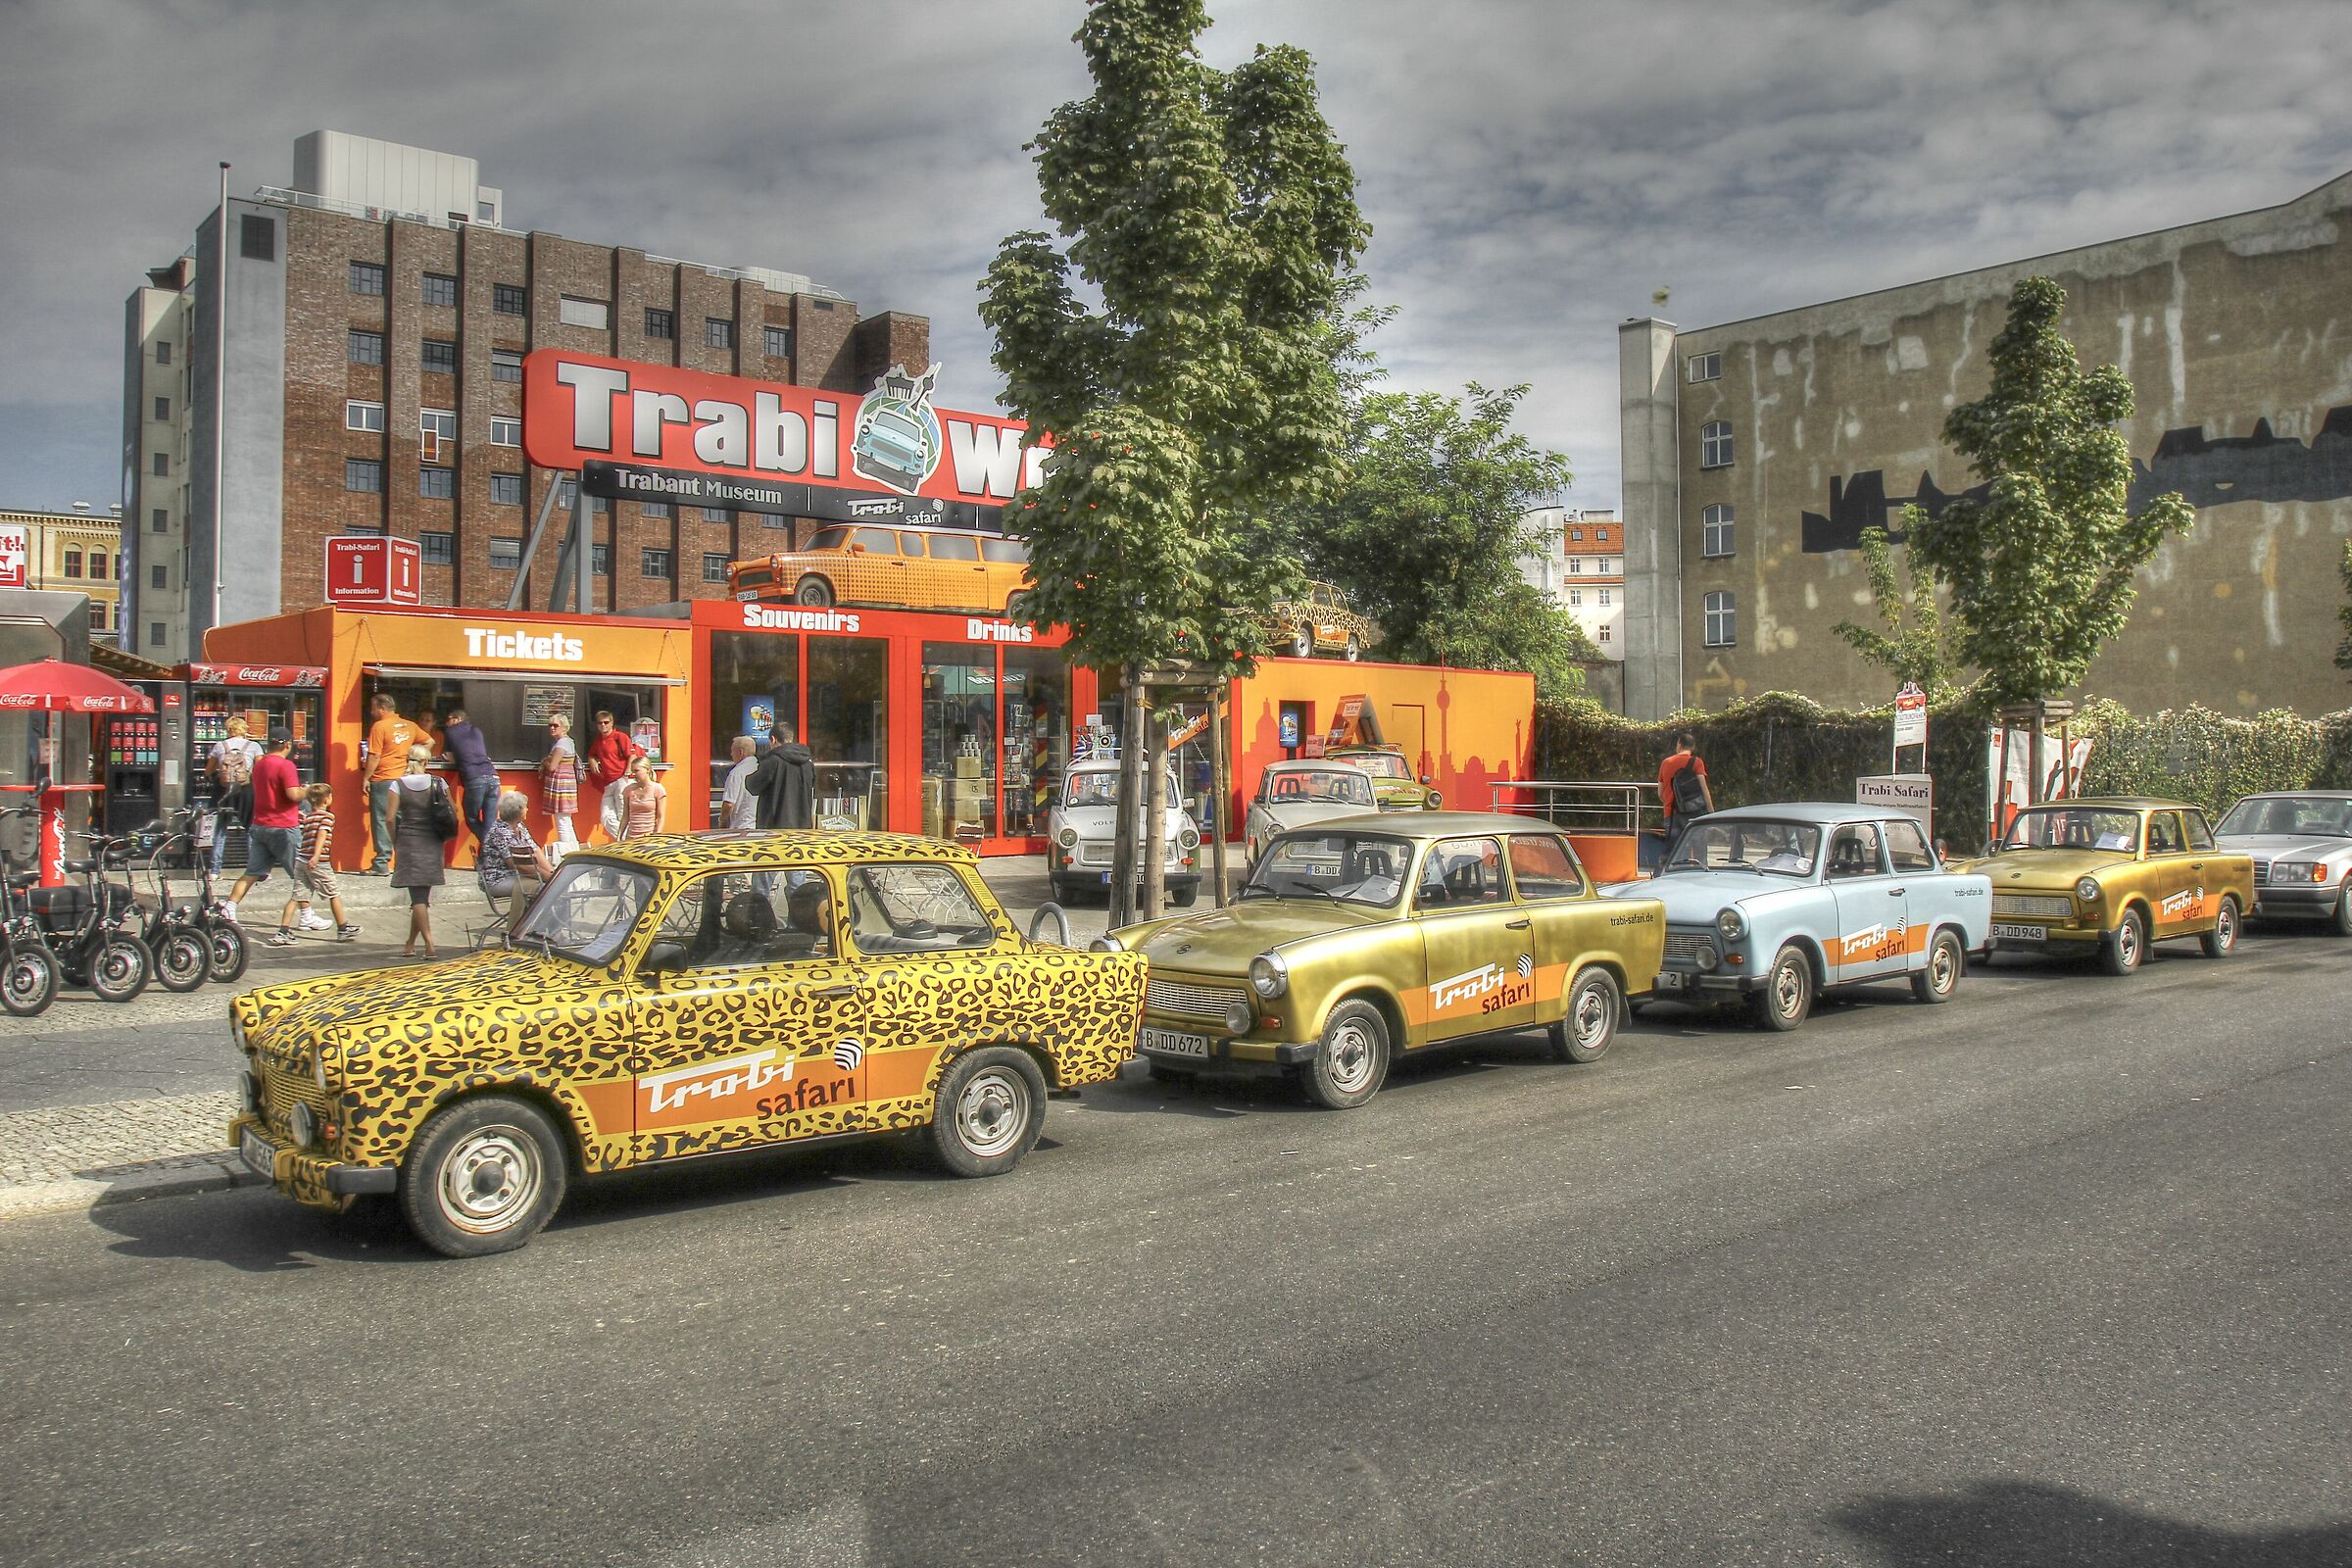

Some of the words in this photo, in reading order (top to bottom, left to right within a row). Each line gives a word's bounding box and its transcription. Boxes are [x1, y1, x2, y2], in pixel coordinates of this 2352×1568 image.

[557, 361, 839, 478] Trabi
[614, 468, 701, 496] Trabant
[707, 480, 782, 504] Museum
[847, 498, 905, 516] Trabi
[906, 511, 942, 524] safari
[743, 604, 860, 632] Souvenirs
[967, 618, 1033, 643] Drinks
[464, 627, 583, 662] Tickets
[238, 667, 281, 681] Coca-Cola
[0, 694, 38, 706] Coca-Cola
[83, 696, 116, 708] Coca-Cola
[1859, 783, 1890, 796] Trabi
[1894, 784, 1929, 799] Safari
[2161, 889, 2192, 916] Trabi
[2182, 904, 2203, 921] safari
[1610, 912, 1654, 926] trabi-safari.de
[1992, 926, 1999, 936] B
[1840, 922, 1887, 956] Trabi
[1875, 939, 1905, 961] safari
[1429, 962, 1504, 1009] Trabi
[1482, 982, 1530, 1015] safari
[1146, 1031, 1153, 1048] B
[639, 1049, 796, 1113] Trabi
[756, 1076, 856, 1120] safari
